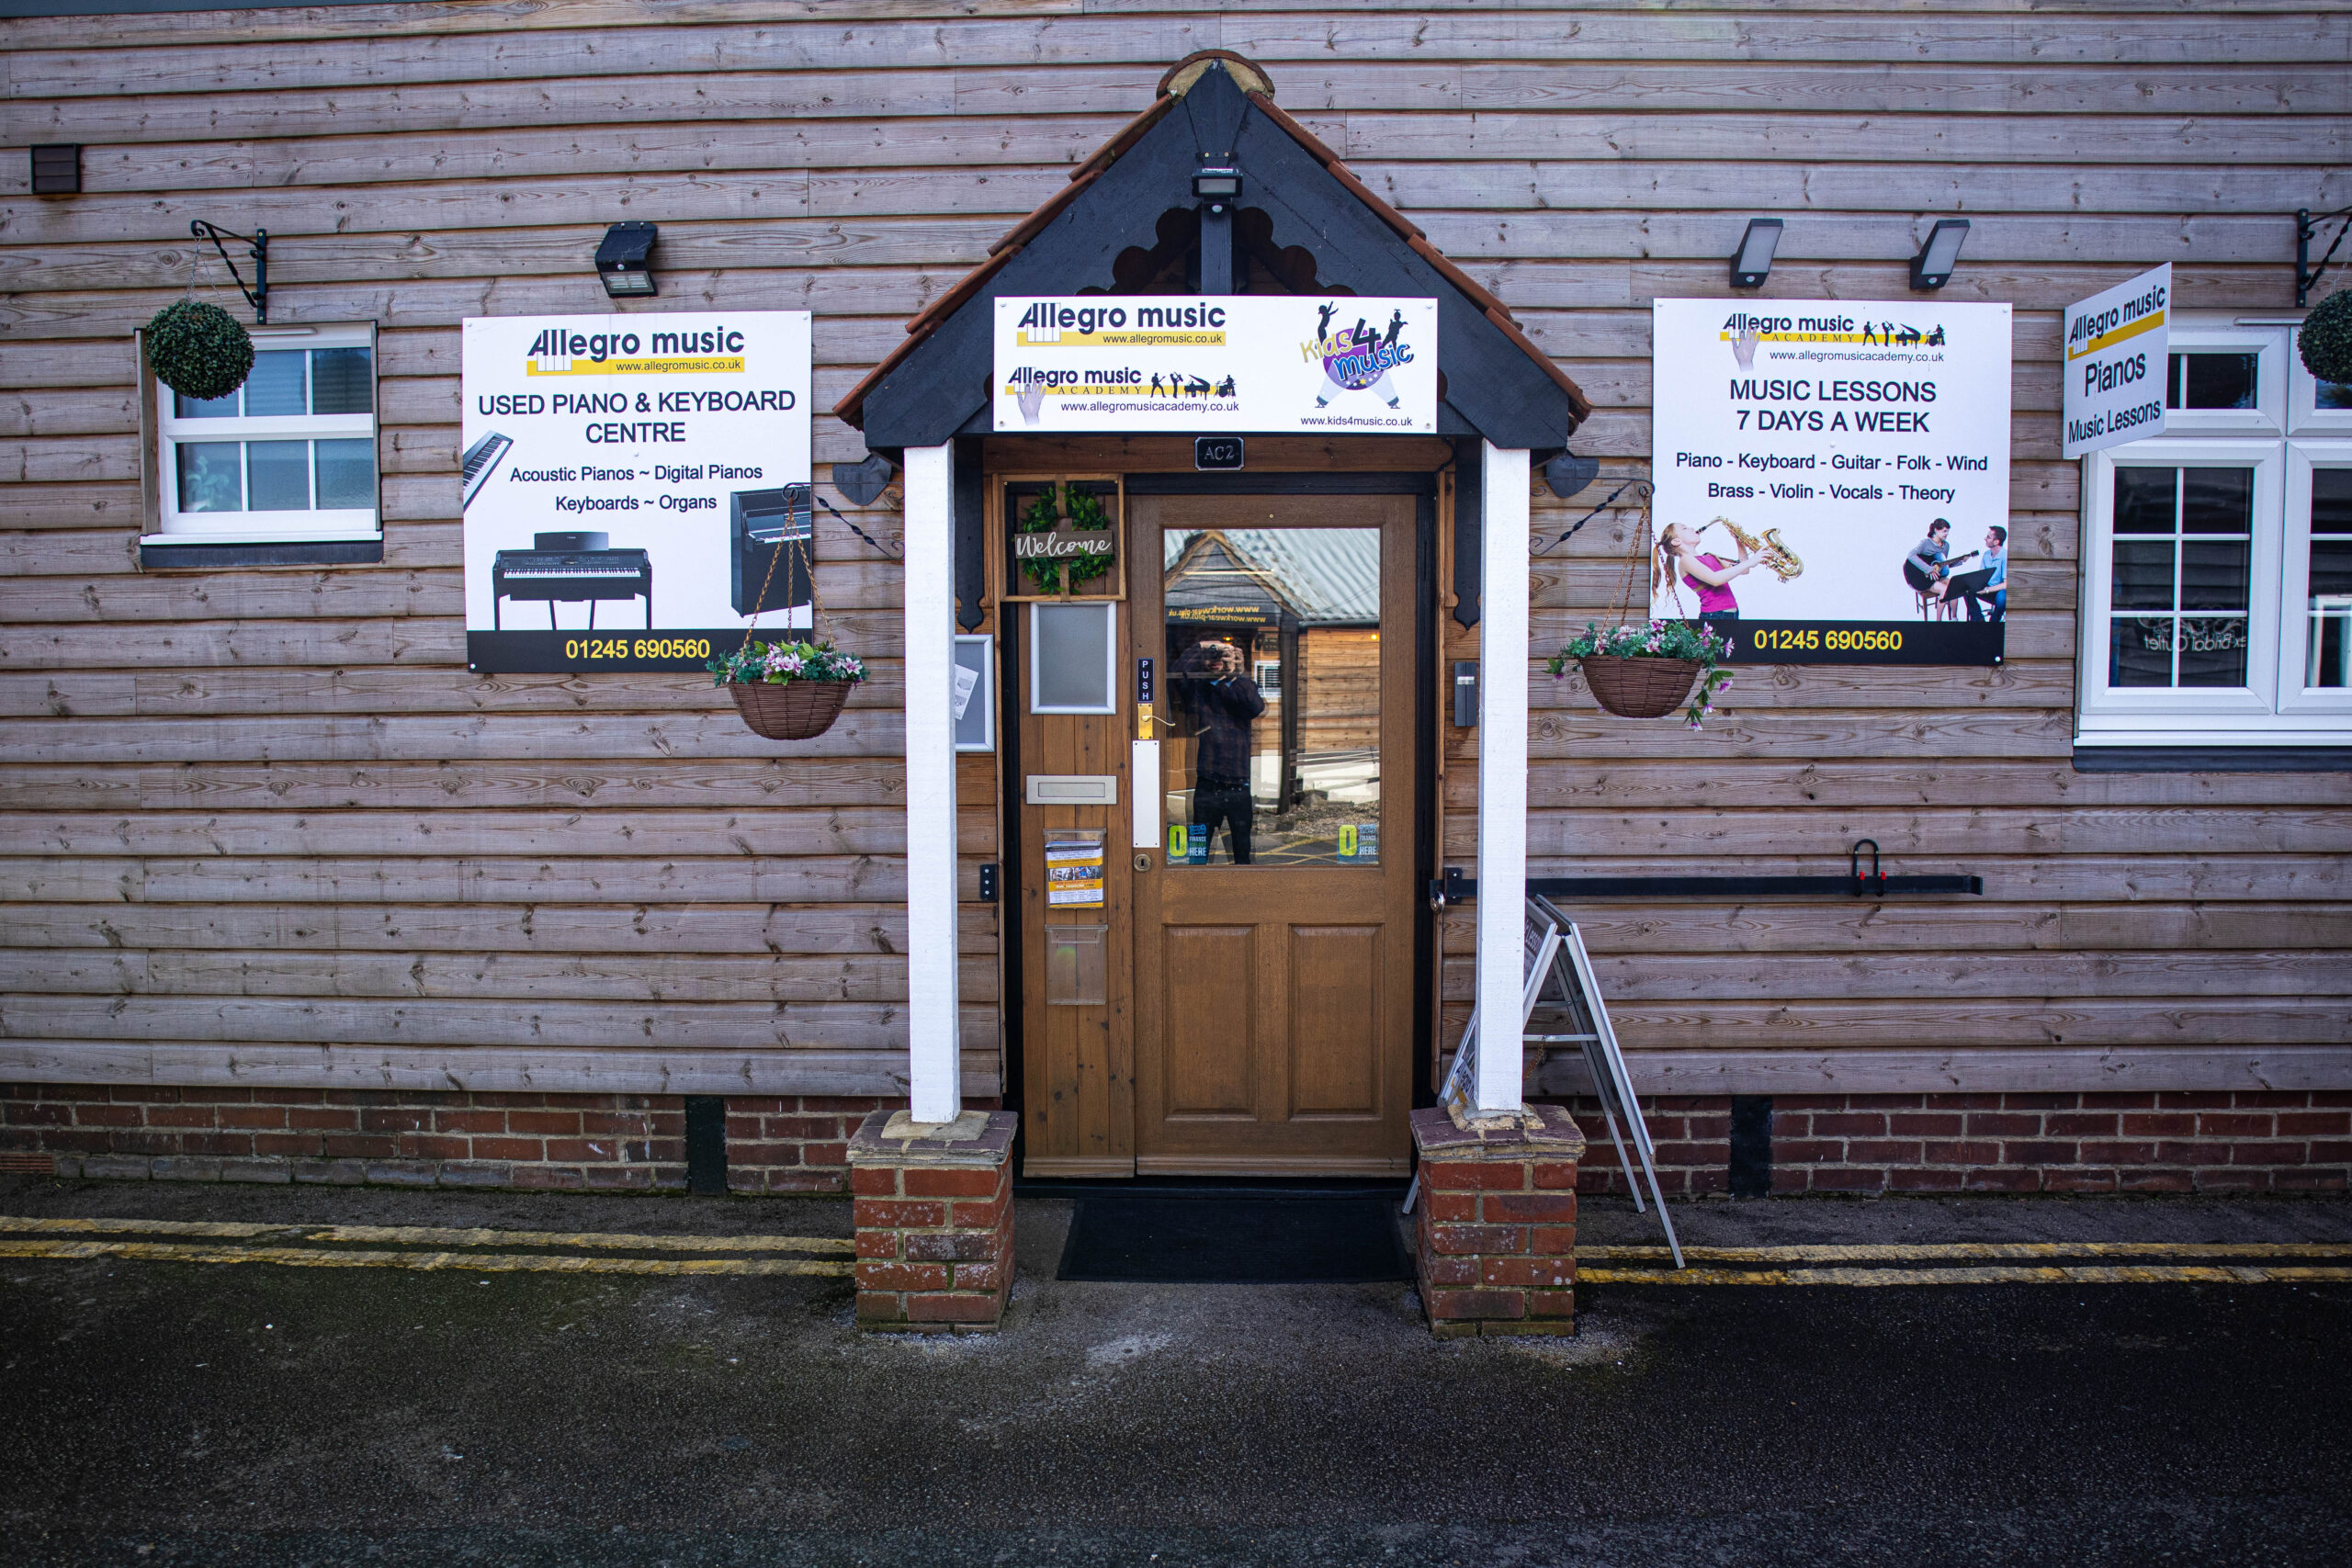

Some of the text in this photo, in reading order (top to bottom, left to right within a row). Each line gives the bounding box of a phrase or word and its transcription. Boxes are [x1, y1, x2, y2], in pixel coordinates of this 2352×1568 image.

[1018, 302, 1226, 335] Allegro music
[1723, 313, 1854, 335] Allegro music
[2068, 285, 2165, 344] Allegro music
[526, 326, 745, 362] Allegro music
[1102, 333, 1223, 345] www.allegromusic.co.uk
[1299, 318, 1381, 364] Kids 4
[1771, 333, 1856, 344] ACADEMY
[616, 358, 741, 373] www.allegromusic.co.uk
[1333, 343, 1415, 382] music
[1770, 350, 1944, 364] www.allegromusicacademy.co.uk
[1008, 367, 1142, 389] Allegro music
[2085, 353, 2146, 398] Pianos
[1057, 386, 1143, 395] ACADEMY
[1730, 379, 1937, 403] MUSIC LESSONS
[478, 389, 796, 416] USED PIANO & KEYBOARD
[1060, 400, 1239, 413] www.allegromusicacademy.co.uk
[1300, 415, 1413, 427] www.kids4music.co.uk
[1736, 410, 1930, 433] 7 DAYS A WEEK
[2068, 400, 2161, 445] Music Lessons
[585, 422, 686, 444] CENTRE
[1204, 445, 1235, 461] AC2
[1676, 452, 1723, 468] Piano
[1738, 453, 1815, 472] Keyboard
[1831, 455, 1882, 470] Guitar
[1897, 455, 1931, 470] Folk
[1946, 456, 1988, 471] Wind
[510, 467, 577, 482] Acoustic
[581, 465, 635, 481] Pianos
[654, 464, 704, 483] Digital
[708, 464, 763, 479] Pianos
[555, 495, 639, 514] Keyboards
[659, 494, 718, 513] Organs
[1708, 483, 1754, 499] Brass
[1770, 483, 1814, 499] Violin
[1829, 484, 1883, 500] Vocals
[1898, 485, 1955, 504] Theory
[1016, 531, 1112, 558] Welcome
[565, 638, 710, 660] 01245 690560
[1753, 630, 1903, 650] 01245 690560
[1189, 846, 1206, 856] HERE
[1360, 845, 1376, 855] HERE
